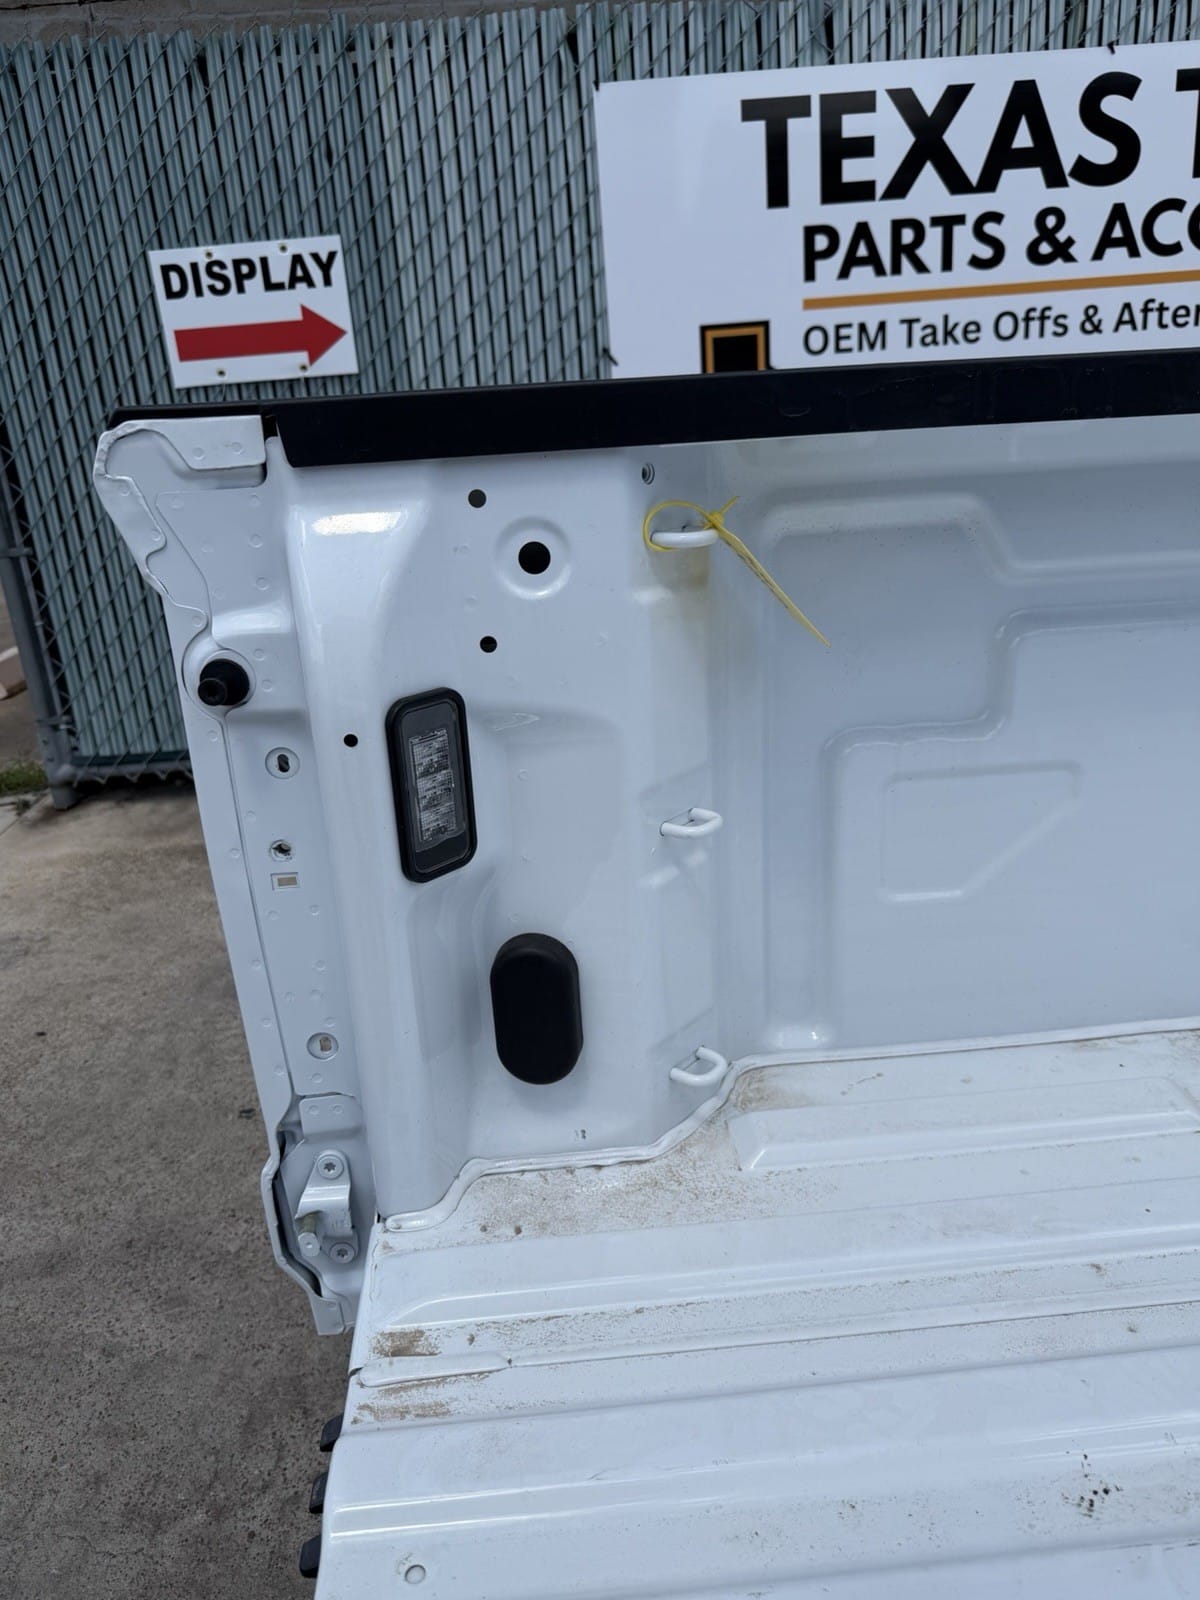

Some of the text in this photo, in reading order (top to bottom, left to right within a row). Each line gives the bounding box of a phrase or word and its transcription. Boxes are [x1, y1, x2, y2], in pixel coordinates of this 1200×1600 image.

[740, 71, 1143, 210] TEXAS
[802, 197, 1200, 283] PARTS & AC
[159, 250, 338, 301] DISPLAY
[803, 320, 888, 356] OEM
[900, 313, 983, 351] Take
[993, 305, 1069, 343] Offs
[1079, 304, 1104, 337] &
